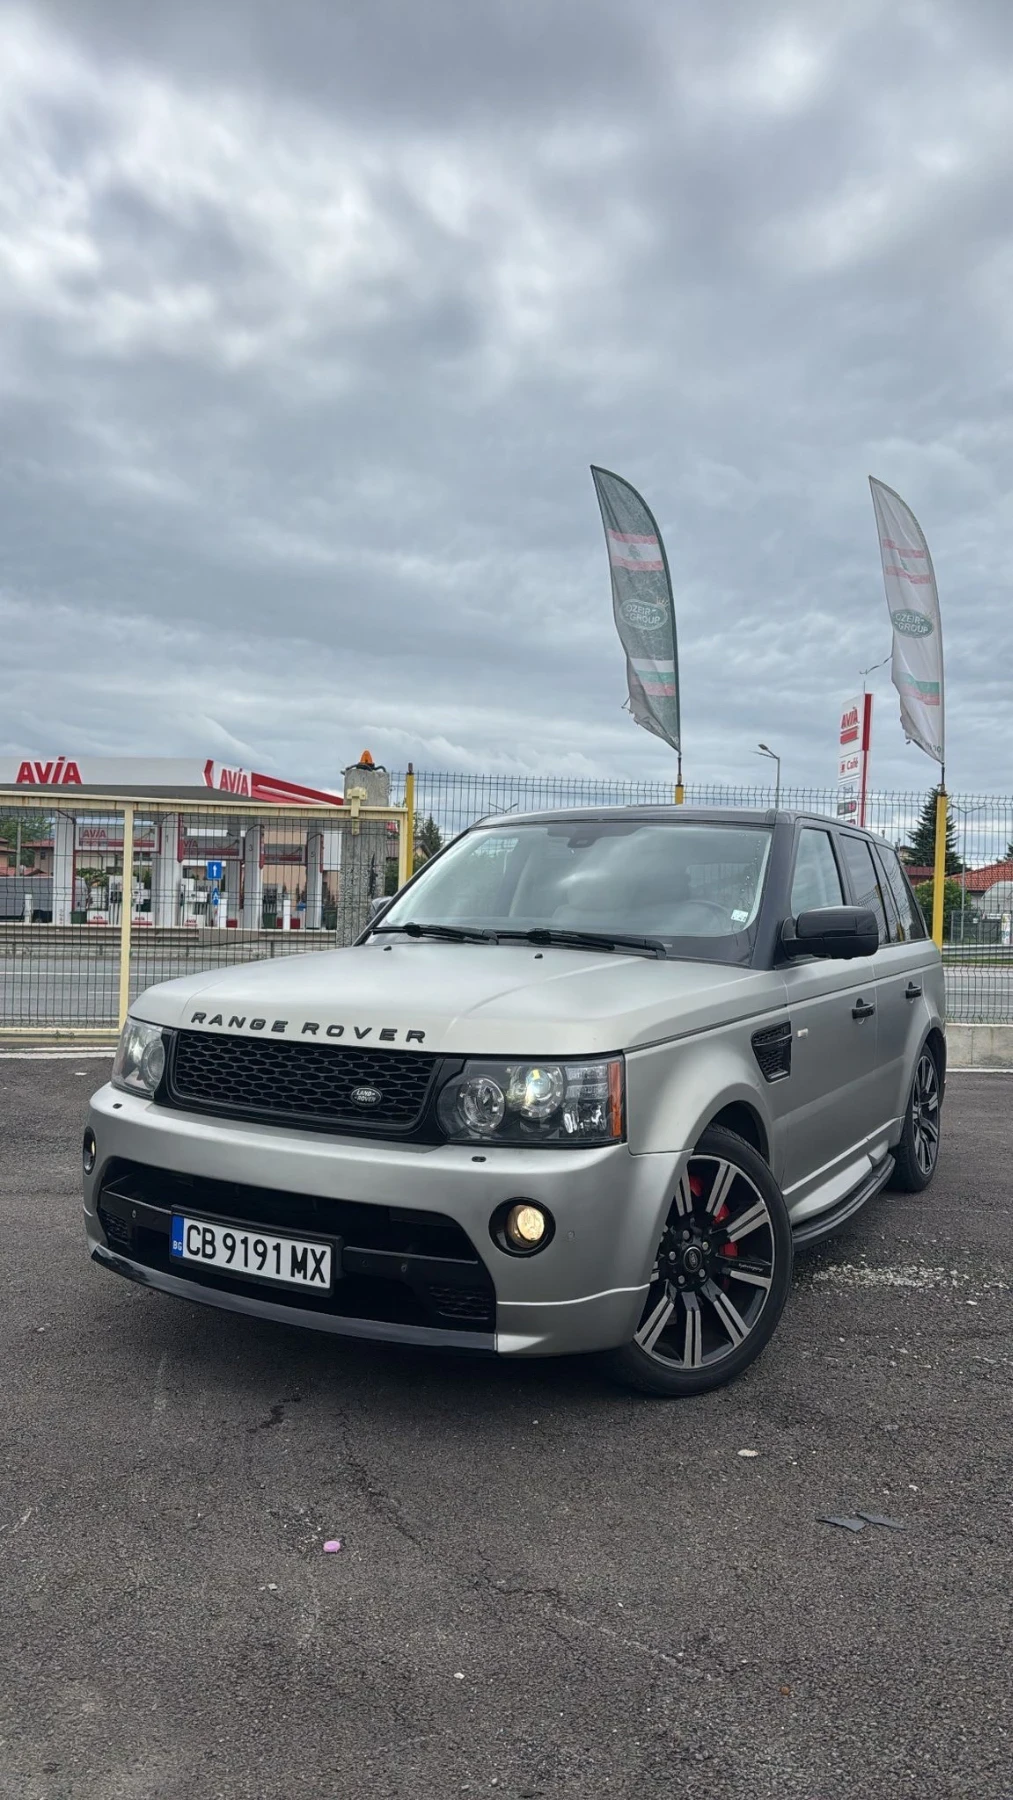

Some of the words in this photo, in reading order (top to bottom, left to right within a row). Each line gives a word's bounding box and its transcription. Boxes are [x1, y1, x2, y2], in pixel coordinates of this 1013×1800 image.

[190, 1011, 289, 1033] RANGE
[301, 1021, 427, 1044] ROVER
[172, 1240, 183, 1251] BG
